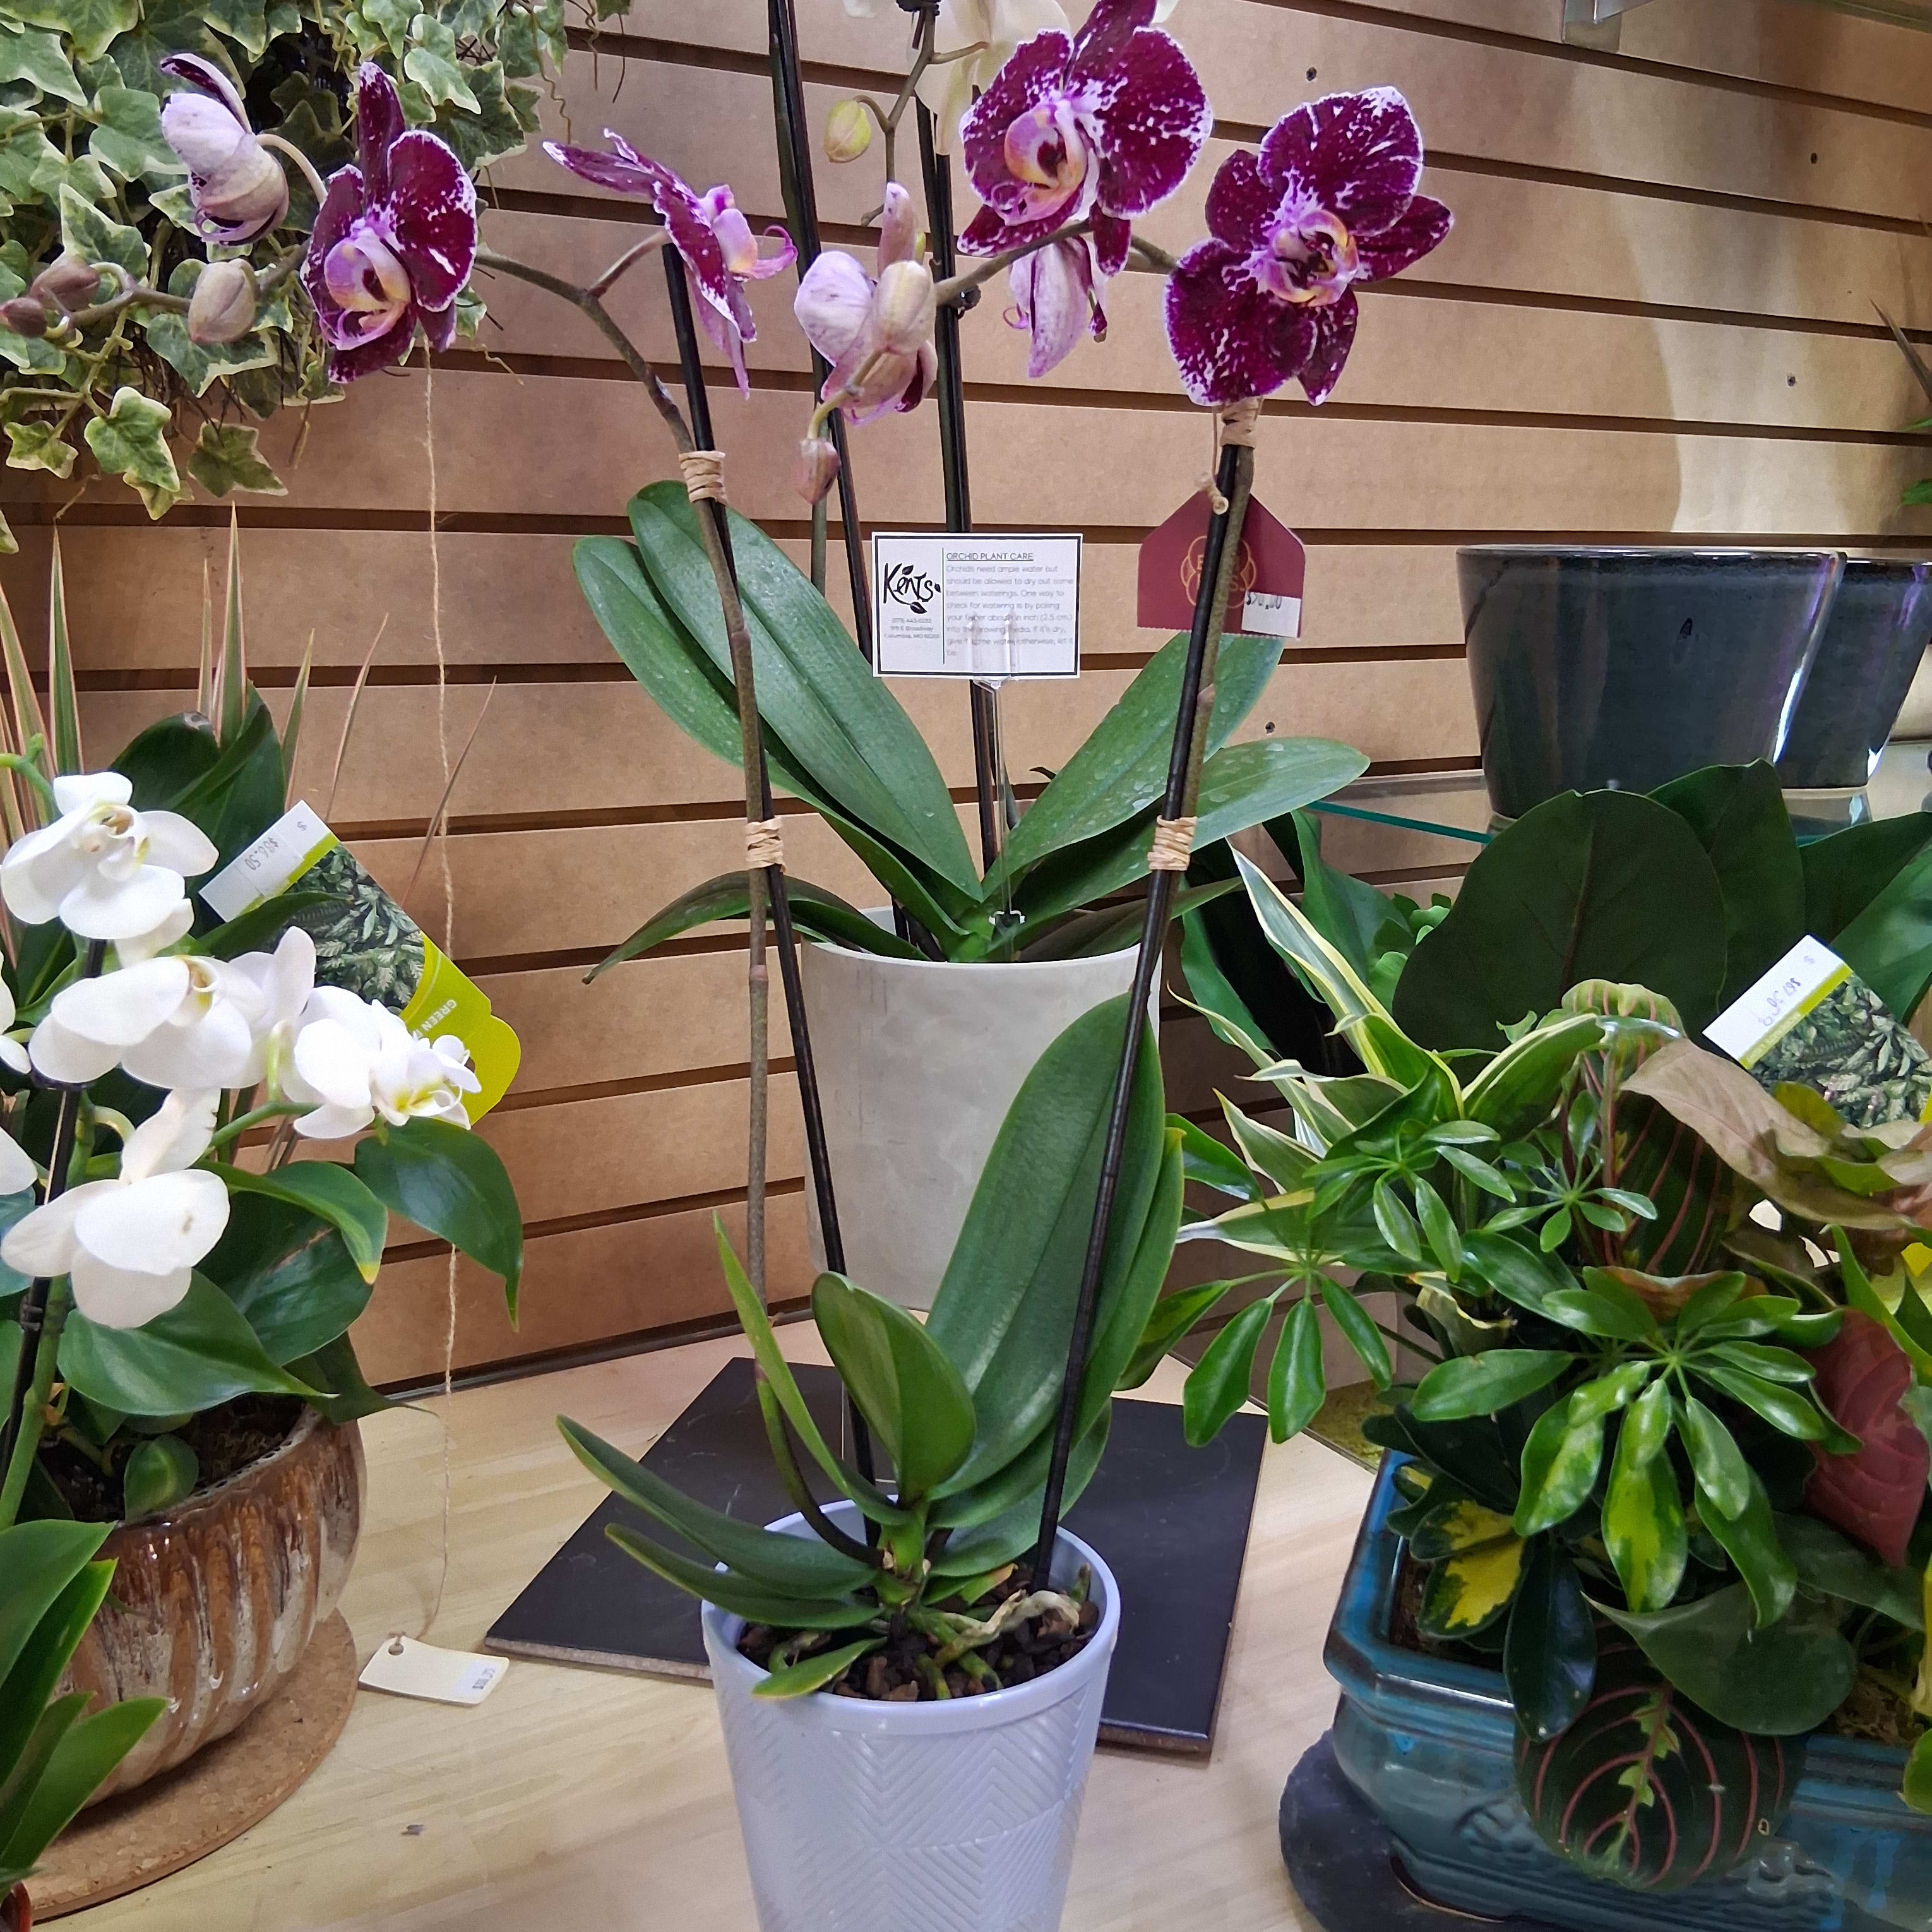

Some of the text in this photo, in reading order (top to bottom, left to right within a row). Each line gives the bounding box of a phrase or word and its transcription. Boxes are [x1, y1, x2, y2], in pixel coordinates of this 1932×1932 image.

[946, 552, 1033, 561] ORCHID PLANT CARE
[982, 602, 1014, 611] watering
[1025, 602, 1033, 611] by
[421, 999, 456, 1032] GREEN
